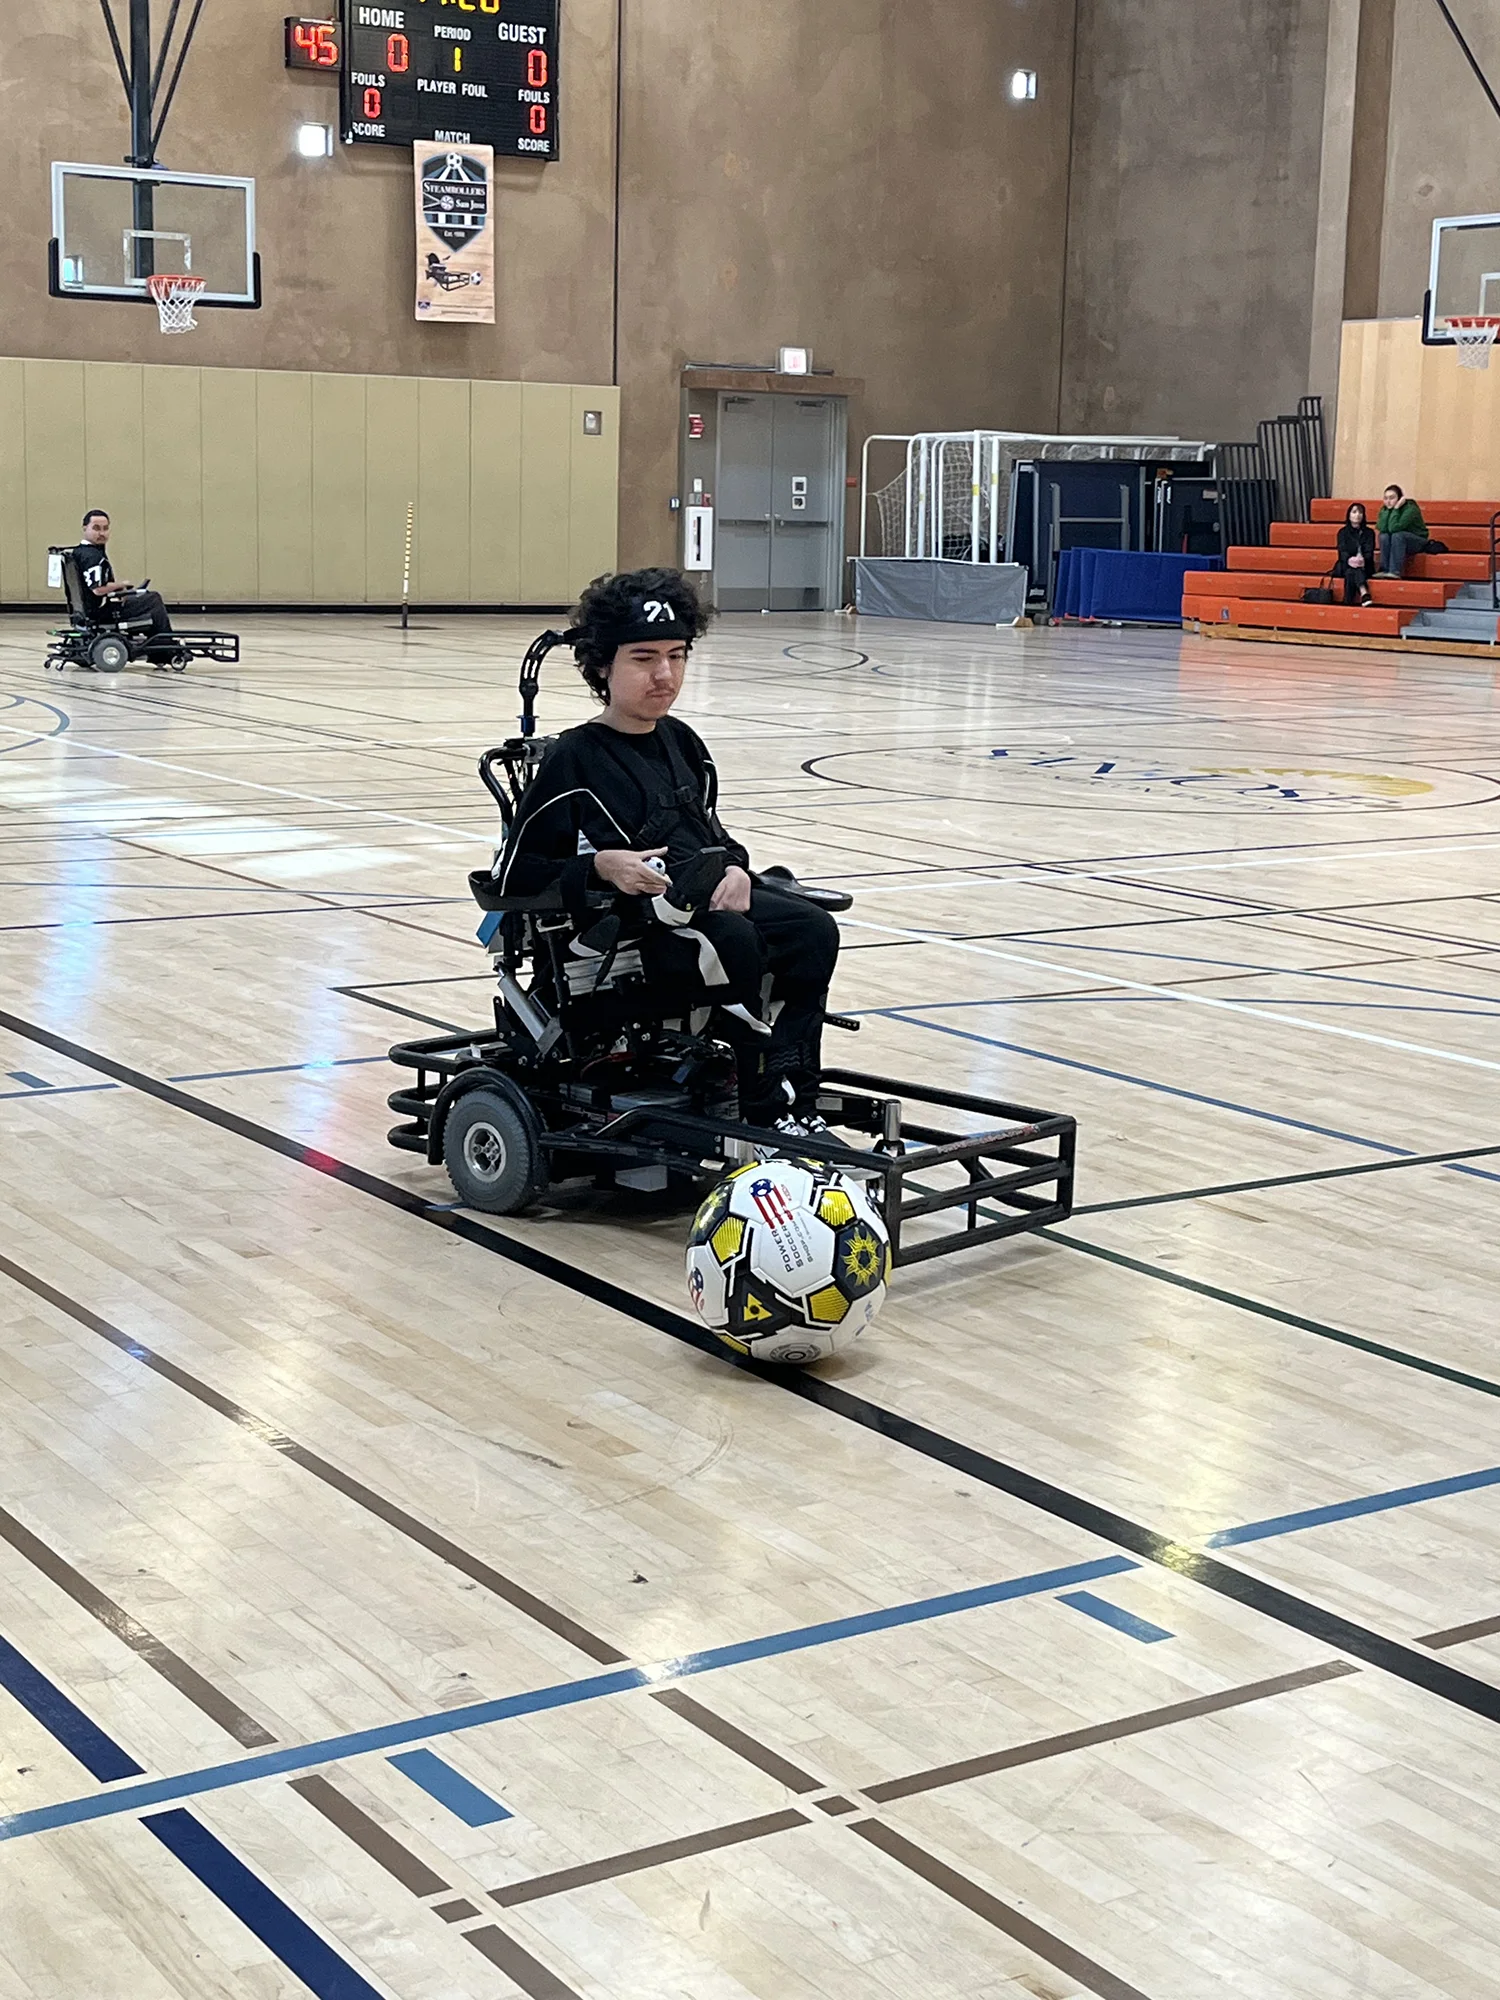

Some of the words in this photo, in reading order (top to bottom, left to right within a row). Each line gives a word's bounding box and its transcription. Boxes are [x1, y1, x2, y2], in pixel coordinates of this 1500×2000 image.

[359, 6, 405, 29] HOME
[434, 25, 472, 41] PERIOD
[498, 22, 547, 45] GUEST
[294, 25, 339, 67] 45
[387, 33, 409, 73] 0
[527, 49, 548, 87] 0
[351, 72, 386, 88] FOULS
[417, 79, 457, 94] PLAYER
[462, 83, 488, 98] FOUL
[363, 87, 381, 119] 0
[518, 89, 550, 104] FOULS
[352, 122, 386, 138] SCORE
[529, 104, 546, 134] 0
[434, 130, 471, 144] MATCH
[517, 138, 550, 152] SCORE
[643, 600, 676, 622] 21
[771, 1228, 795, 1273] POWER
[781, 1224, 804, 1268] SOCCER
